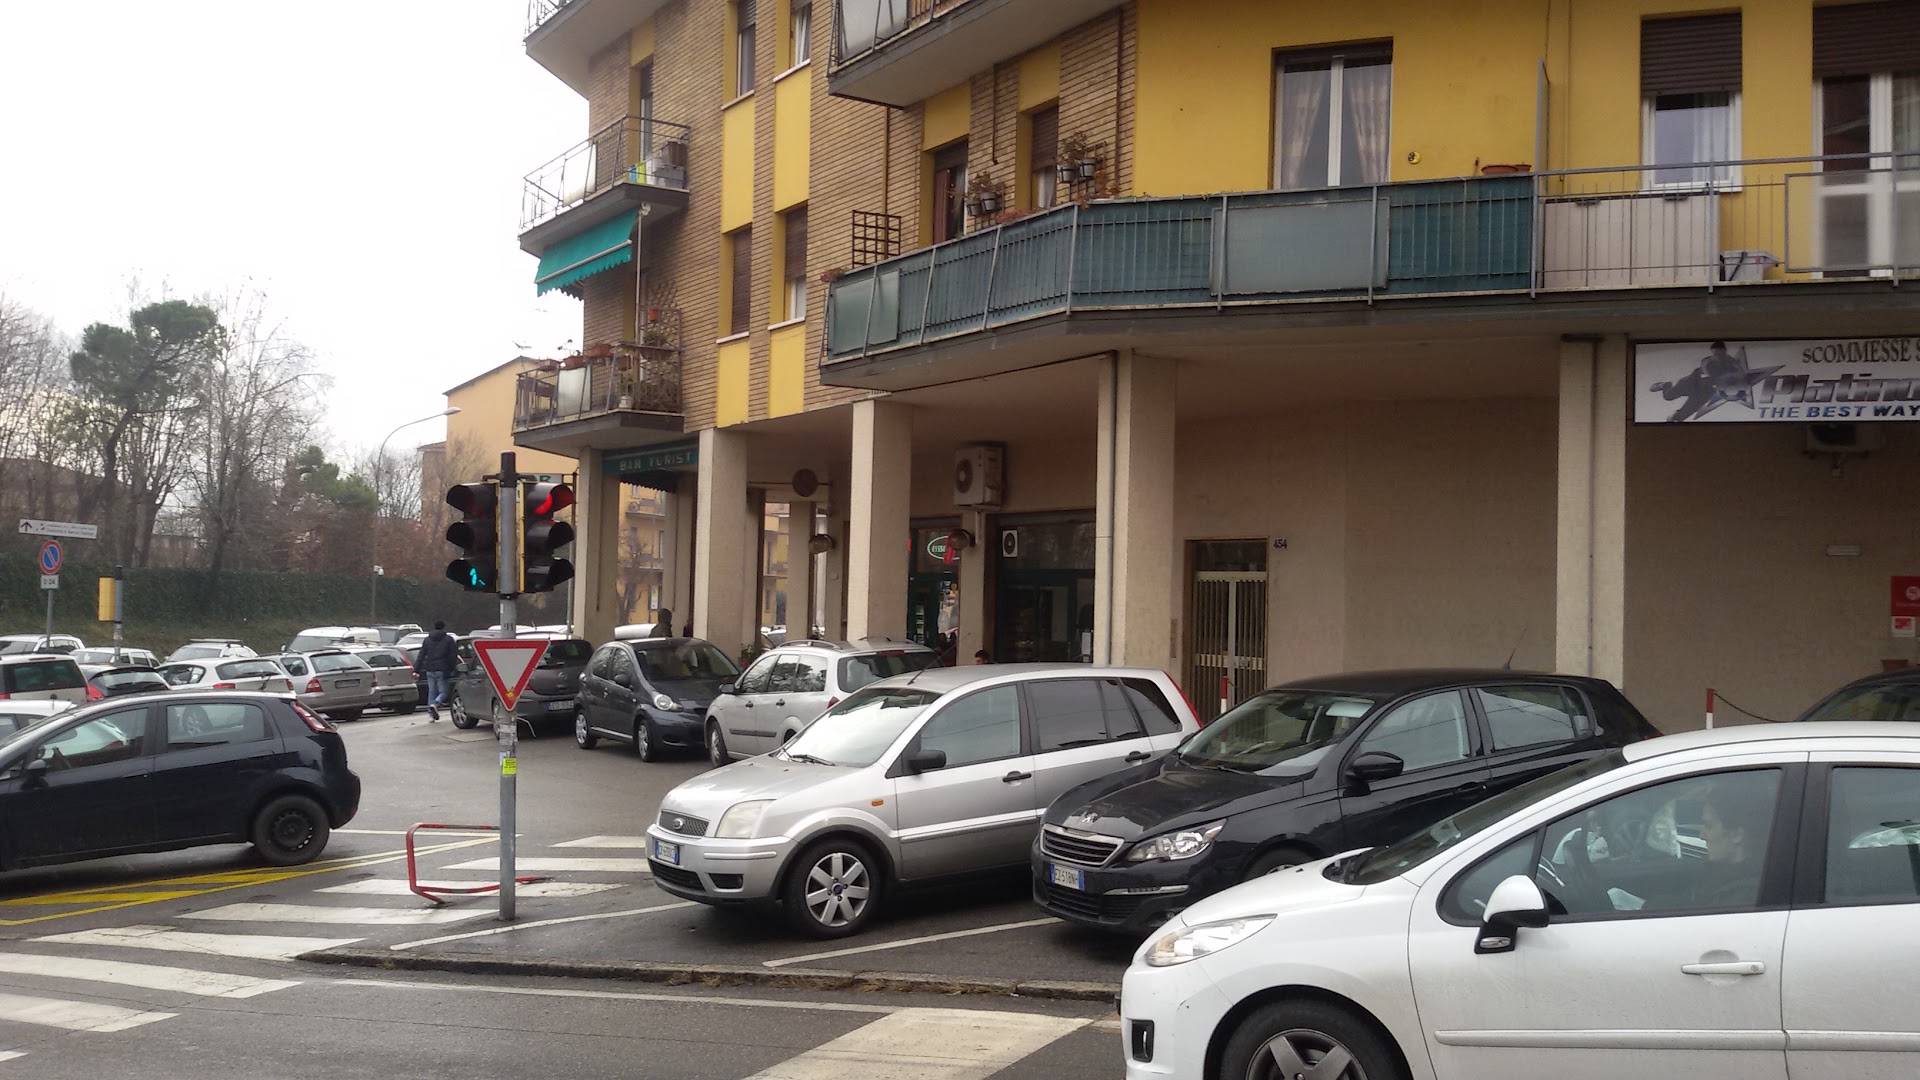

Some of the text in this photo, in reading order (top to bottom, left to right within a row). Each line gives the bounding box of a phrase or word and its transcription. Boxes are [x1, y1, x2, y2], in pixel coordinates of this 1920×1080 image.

[1802, 339, 1912, 363] SCOMMESSE
[1758, 404, 1920, 418] THE BEST WAY
[1273, 538, 1288, 549] 454
